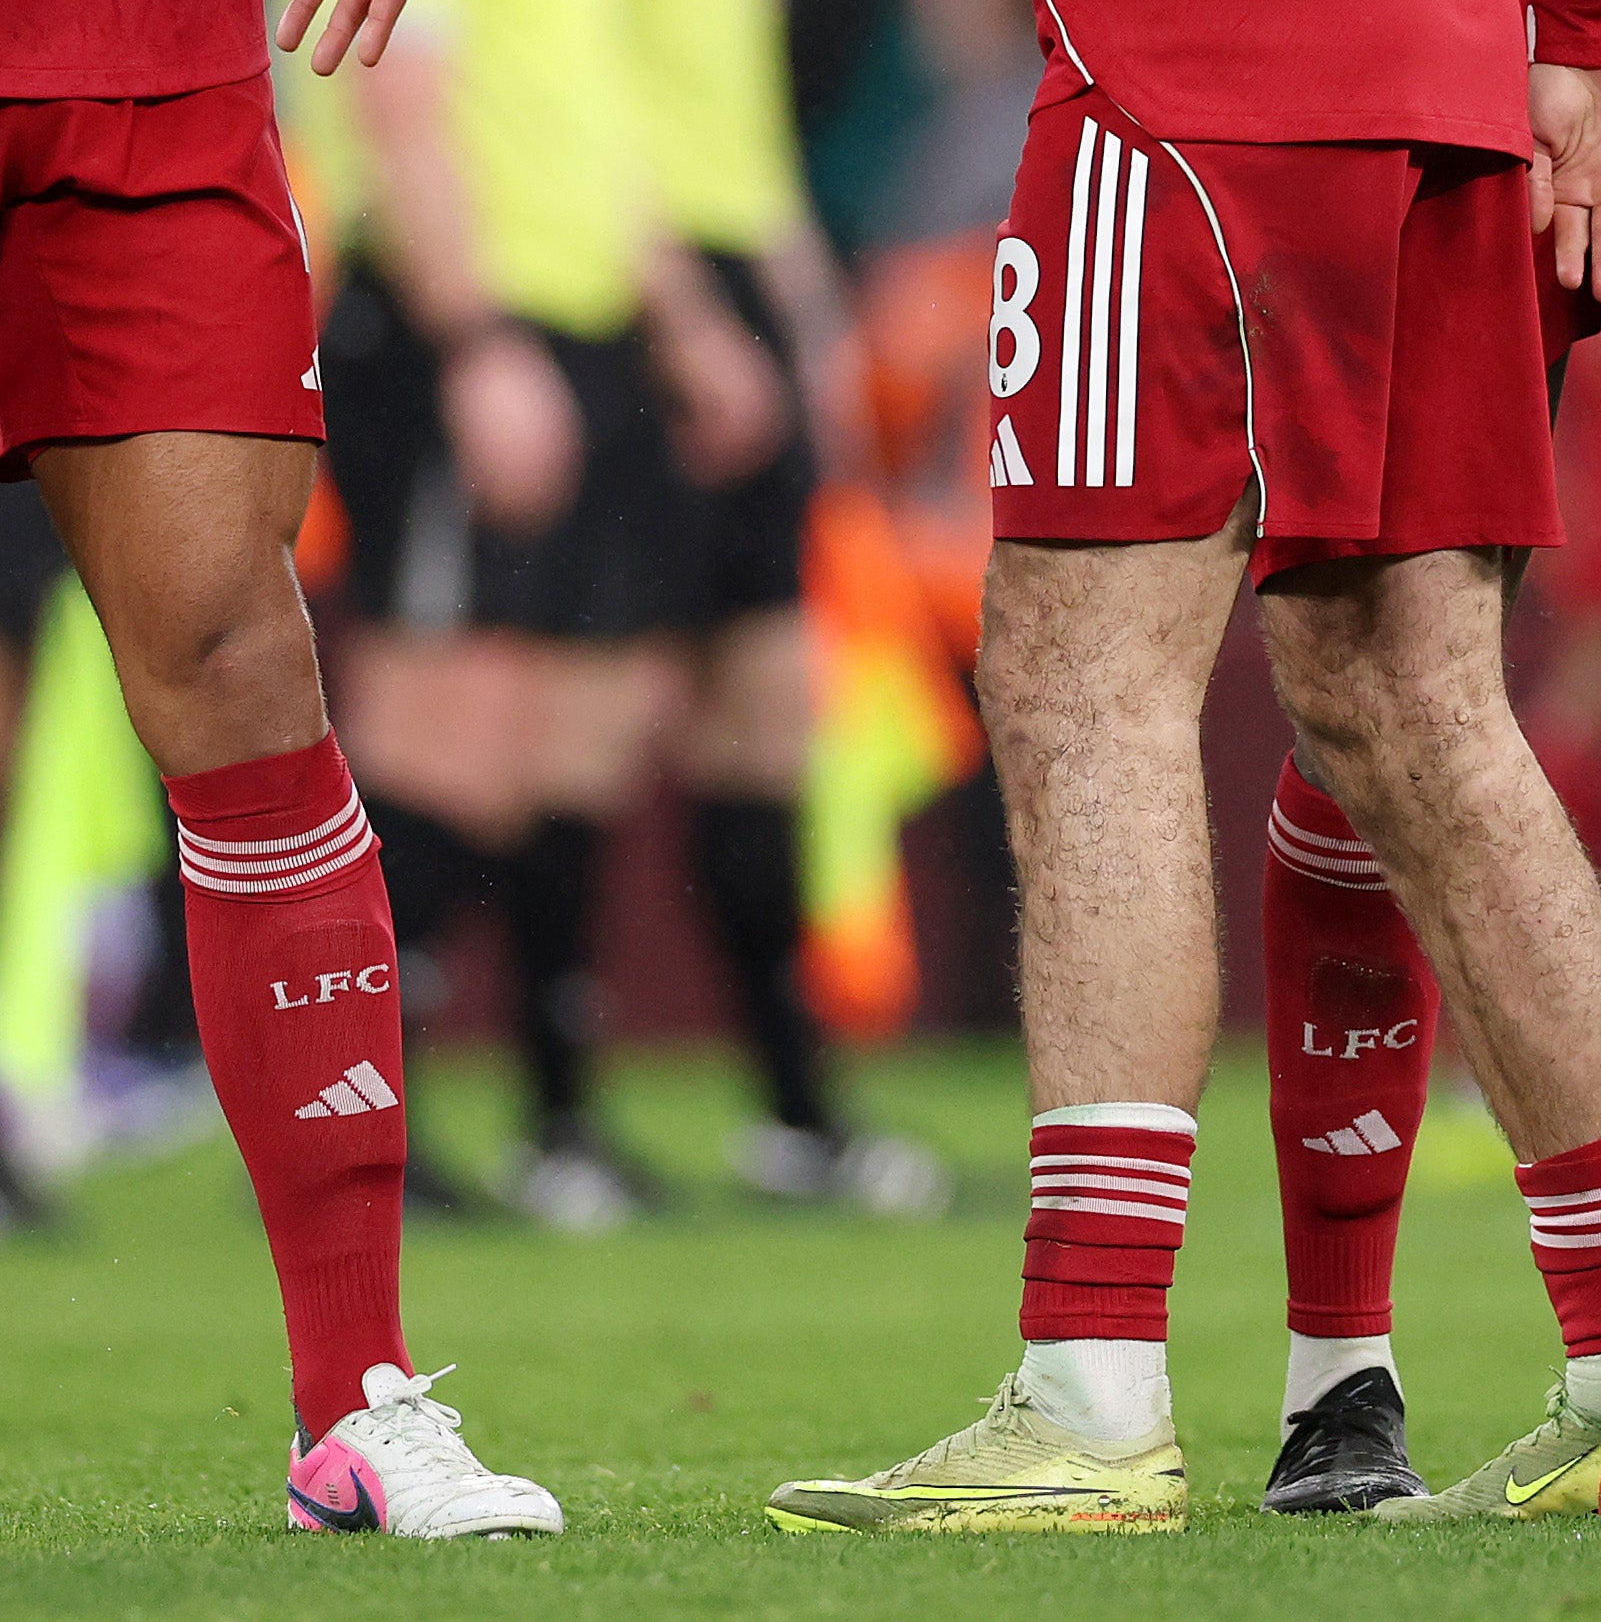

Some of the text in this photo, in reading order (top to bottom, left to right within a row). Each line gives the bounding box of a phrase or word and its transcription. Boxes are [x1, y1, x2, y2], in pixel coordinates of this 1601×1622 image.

[988, 236, 1041, 398] 8
[270, 963, 391, 1011] LFC
[1302, 1018, 1419, 1061] LFC
